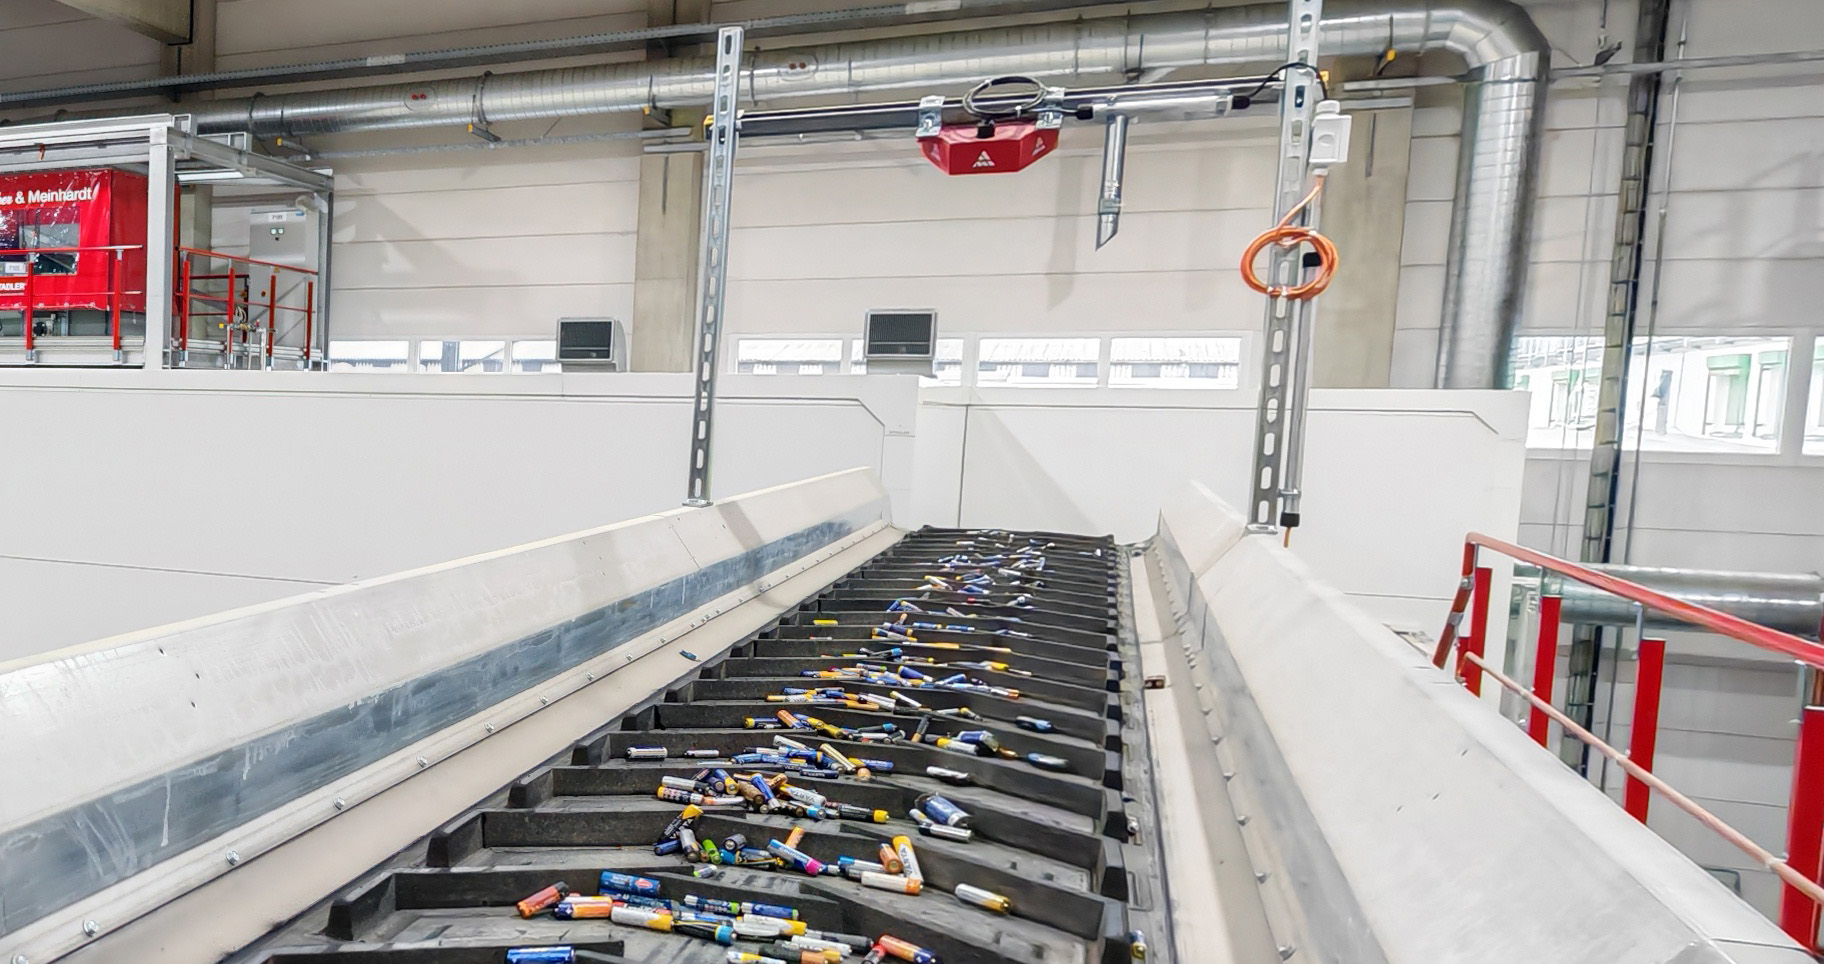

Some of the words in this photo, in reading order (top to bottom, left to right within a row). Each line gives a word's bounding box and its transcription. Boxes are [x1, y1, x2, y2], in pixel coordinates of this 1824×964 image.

[15, 190, 25, 205] &
[28, 186, 93, 204] Meinhardt
[790, 789, 815, 803] VARTA
[900, 847, 914, 877] VARTA
